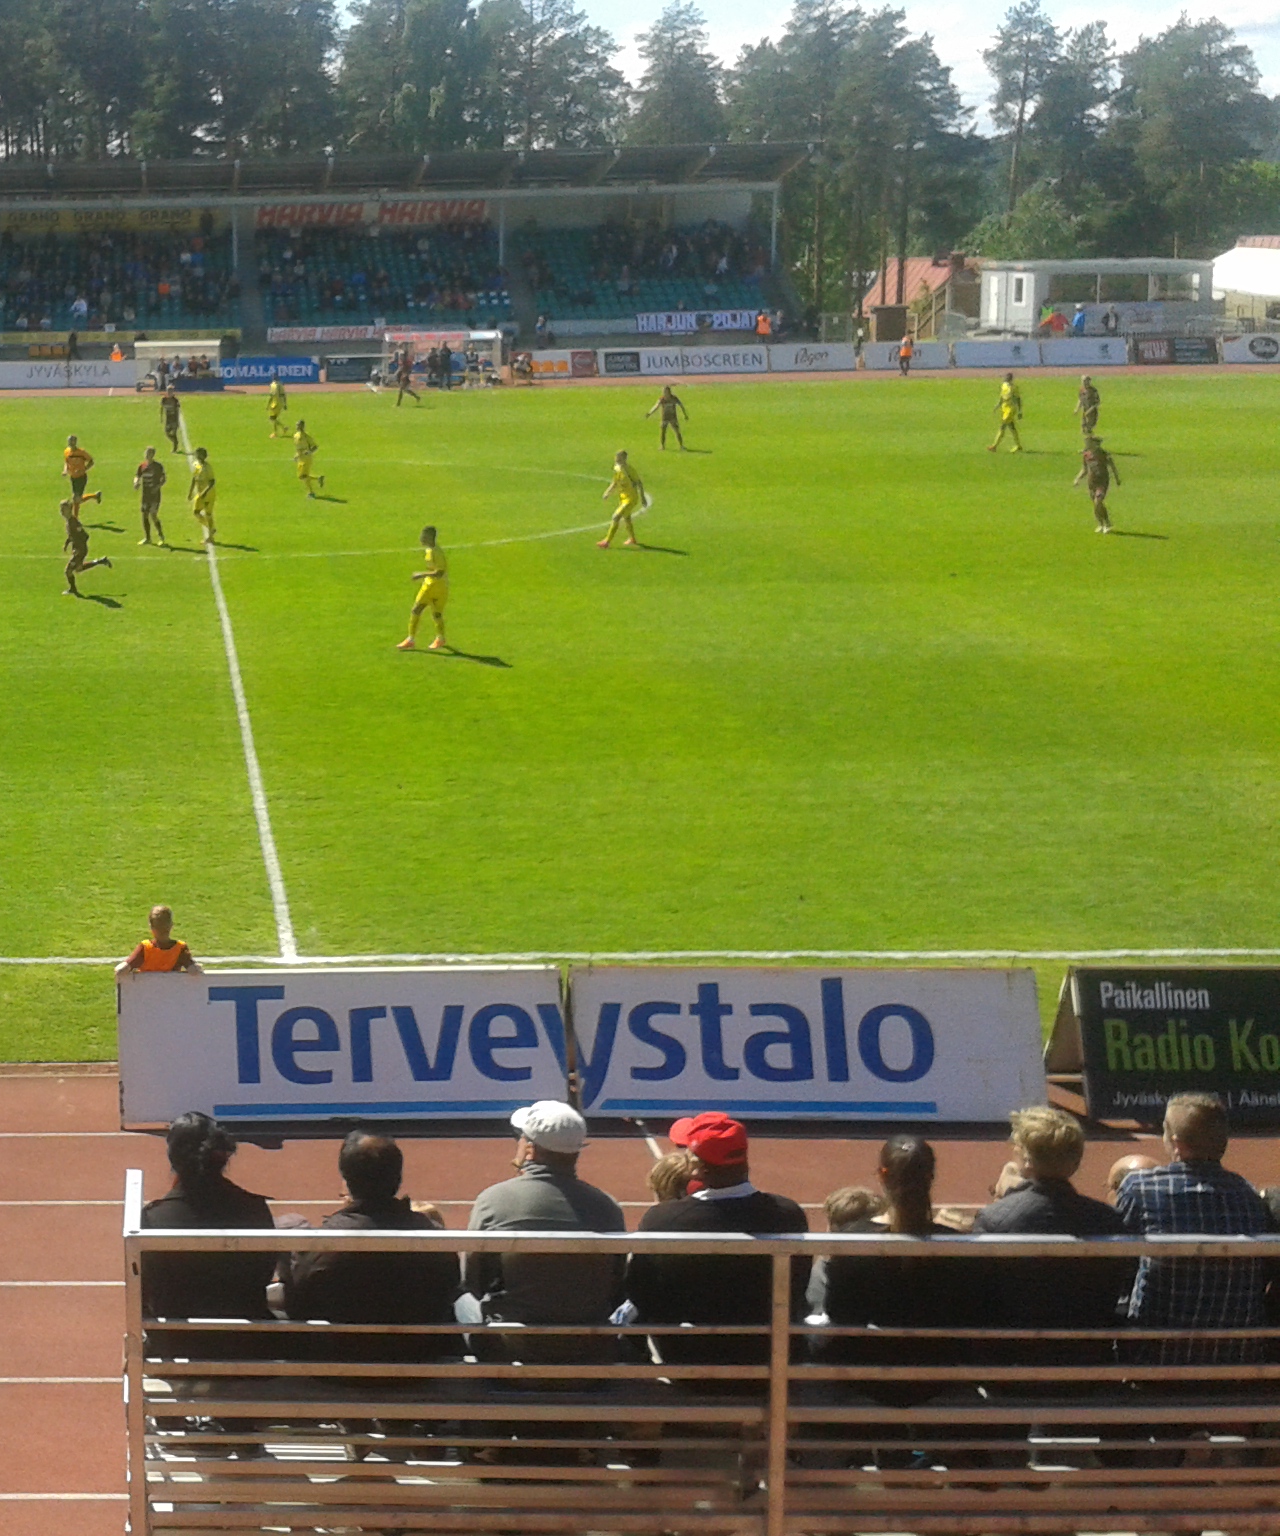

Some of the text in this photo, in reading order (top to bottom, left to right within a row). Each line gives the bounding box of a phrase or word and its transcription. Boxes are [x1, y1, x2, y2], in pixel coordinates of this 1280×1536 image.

[637, 313, 696, 331] HARJUN
[220, 364, 313, 378] OMALAINEN
[646, 352, 763, 369] JUMBOSCREEN
[1100, 981, 1210, 1010] Paikallinen
[208, 977, 935, 1112] Terveystalo
[1104, 1019, 1216, 1071] Radio
